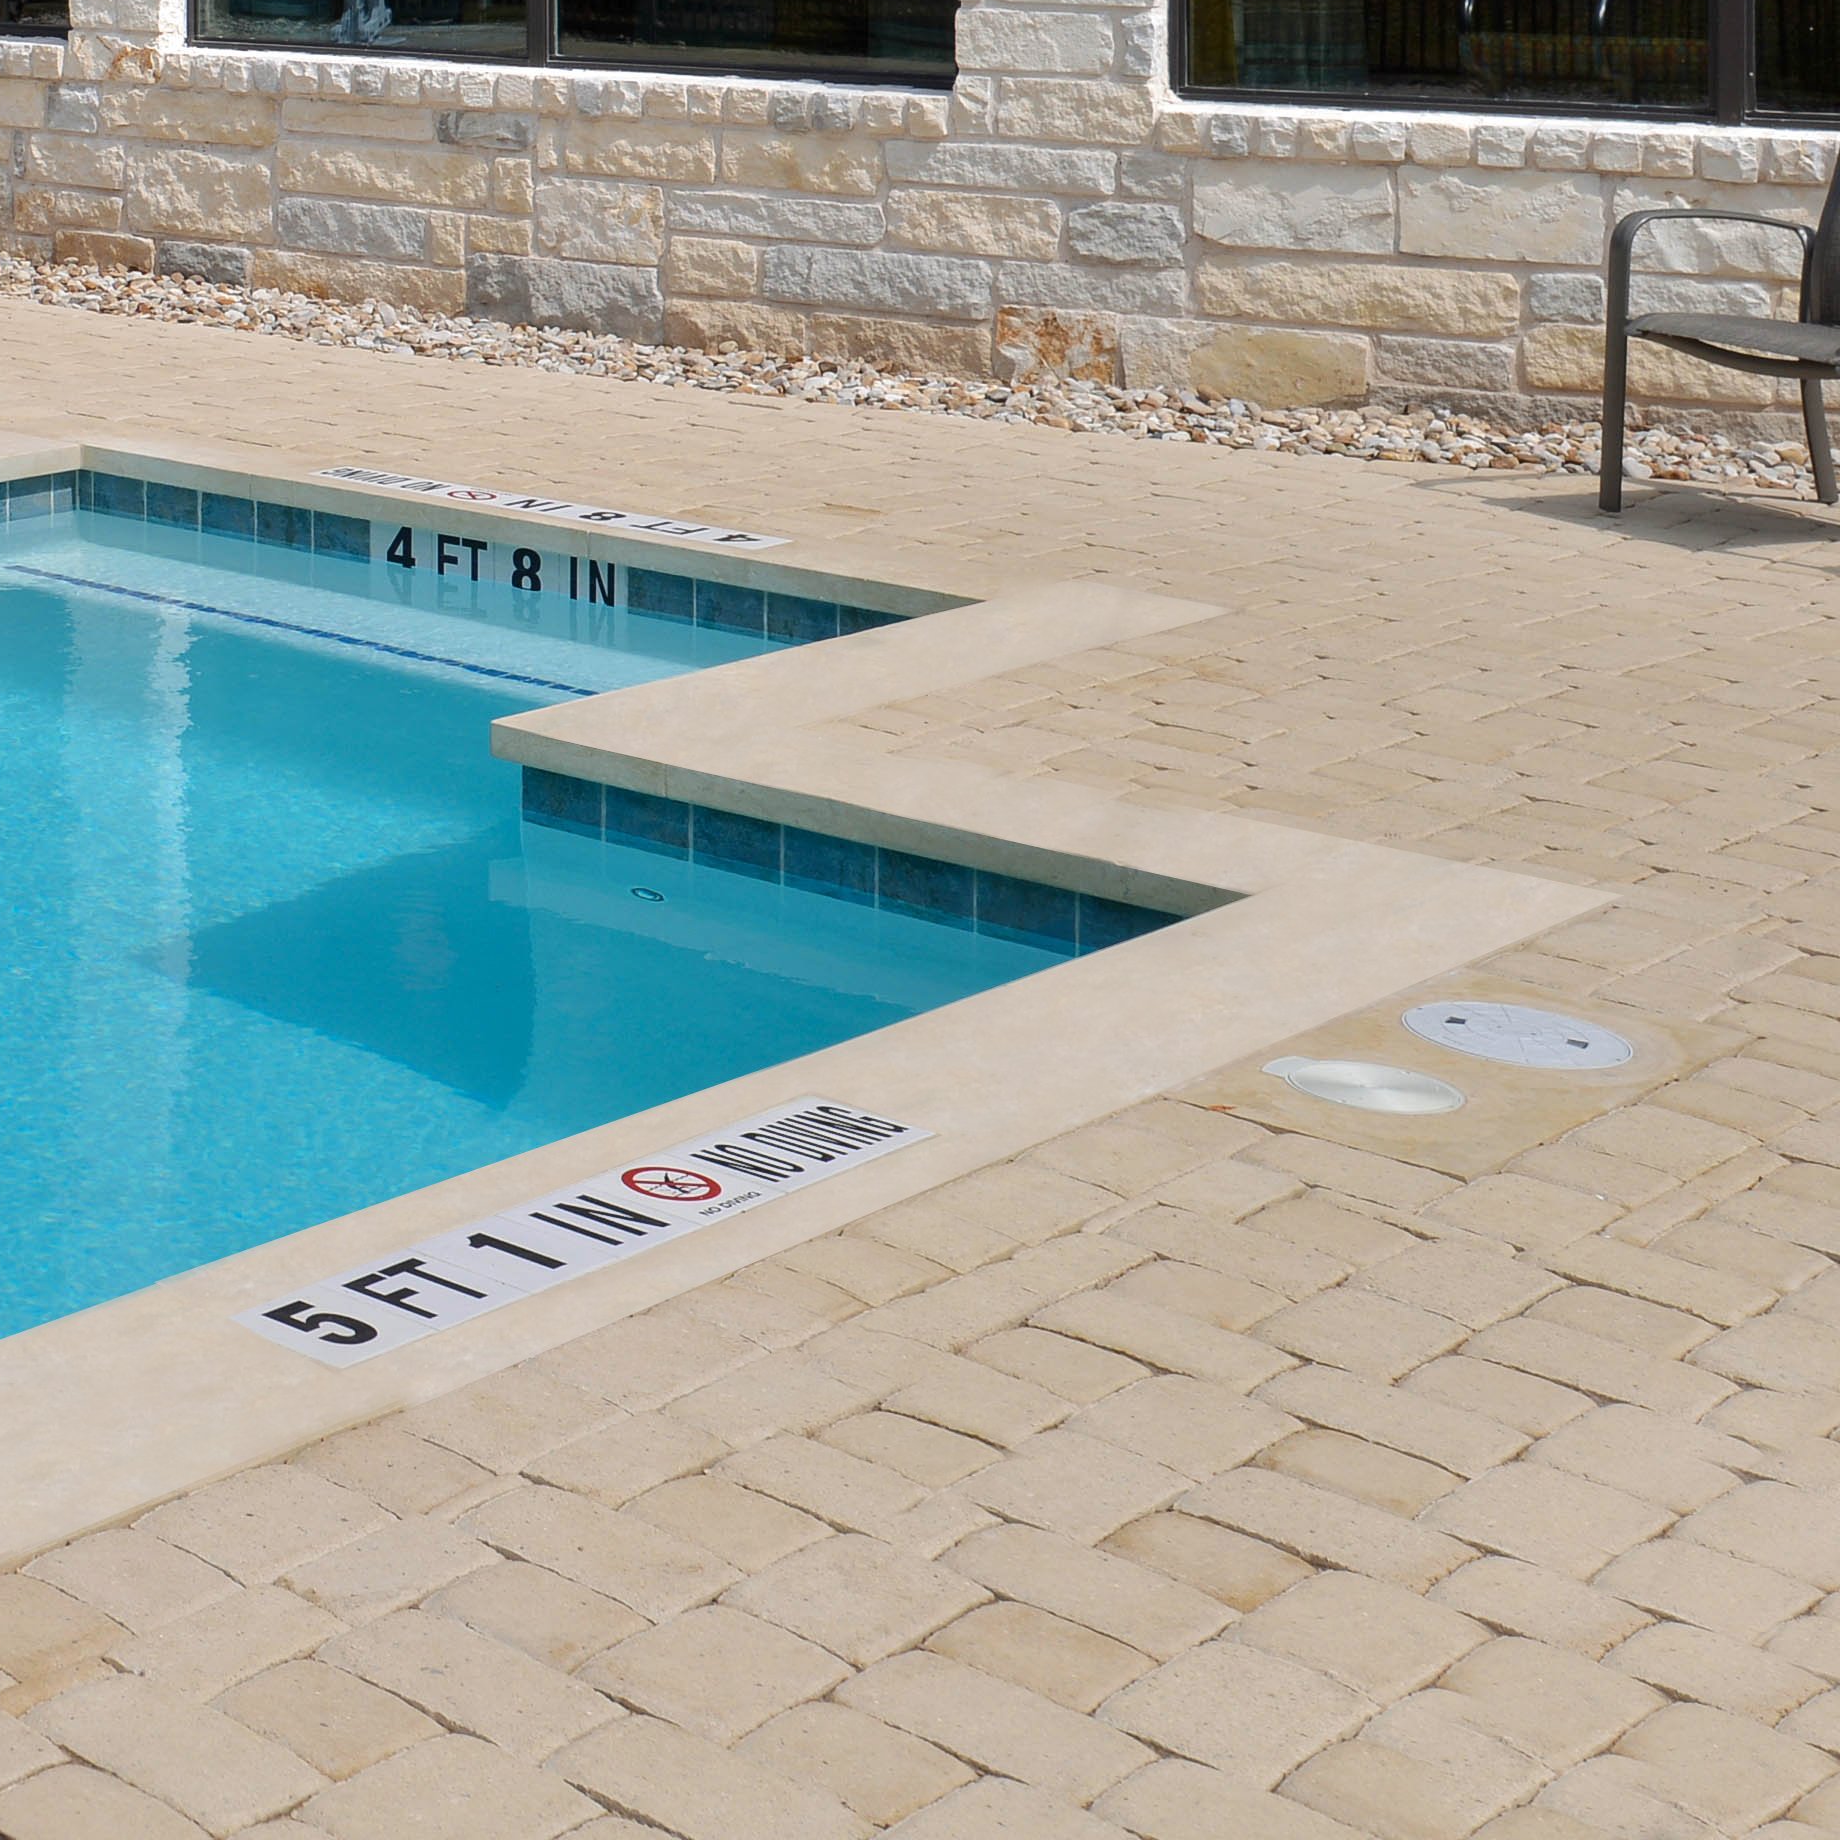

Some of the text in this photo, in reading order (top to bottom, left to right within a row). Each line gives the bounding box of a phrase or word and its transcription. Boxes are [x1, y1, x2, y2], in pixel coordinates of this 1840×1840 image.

[399, 481, 451, 492] NO
[504, 498, 573, 512] IN
[578, 511, 627, 521] 8
[629, 521, 710, 535] FT
[713, 533, 761, 542] 4
[386, 526, 616, 608] 4 FT 8 IN
[689, 1106, 909, 1183] NO DIVING
[698, 1191, 762, 1217] NO DIVING
[262, 1194, 671, 1345] 5 FT 1 IN
